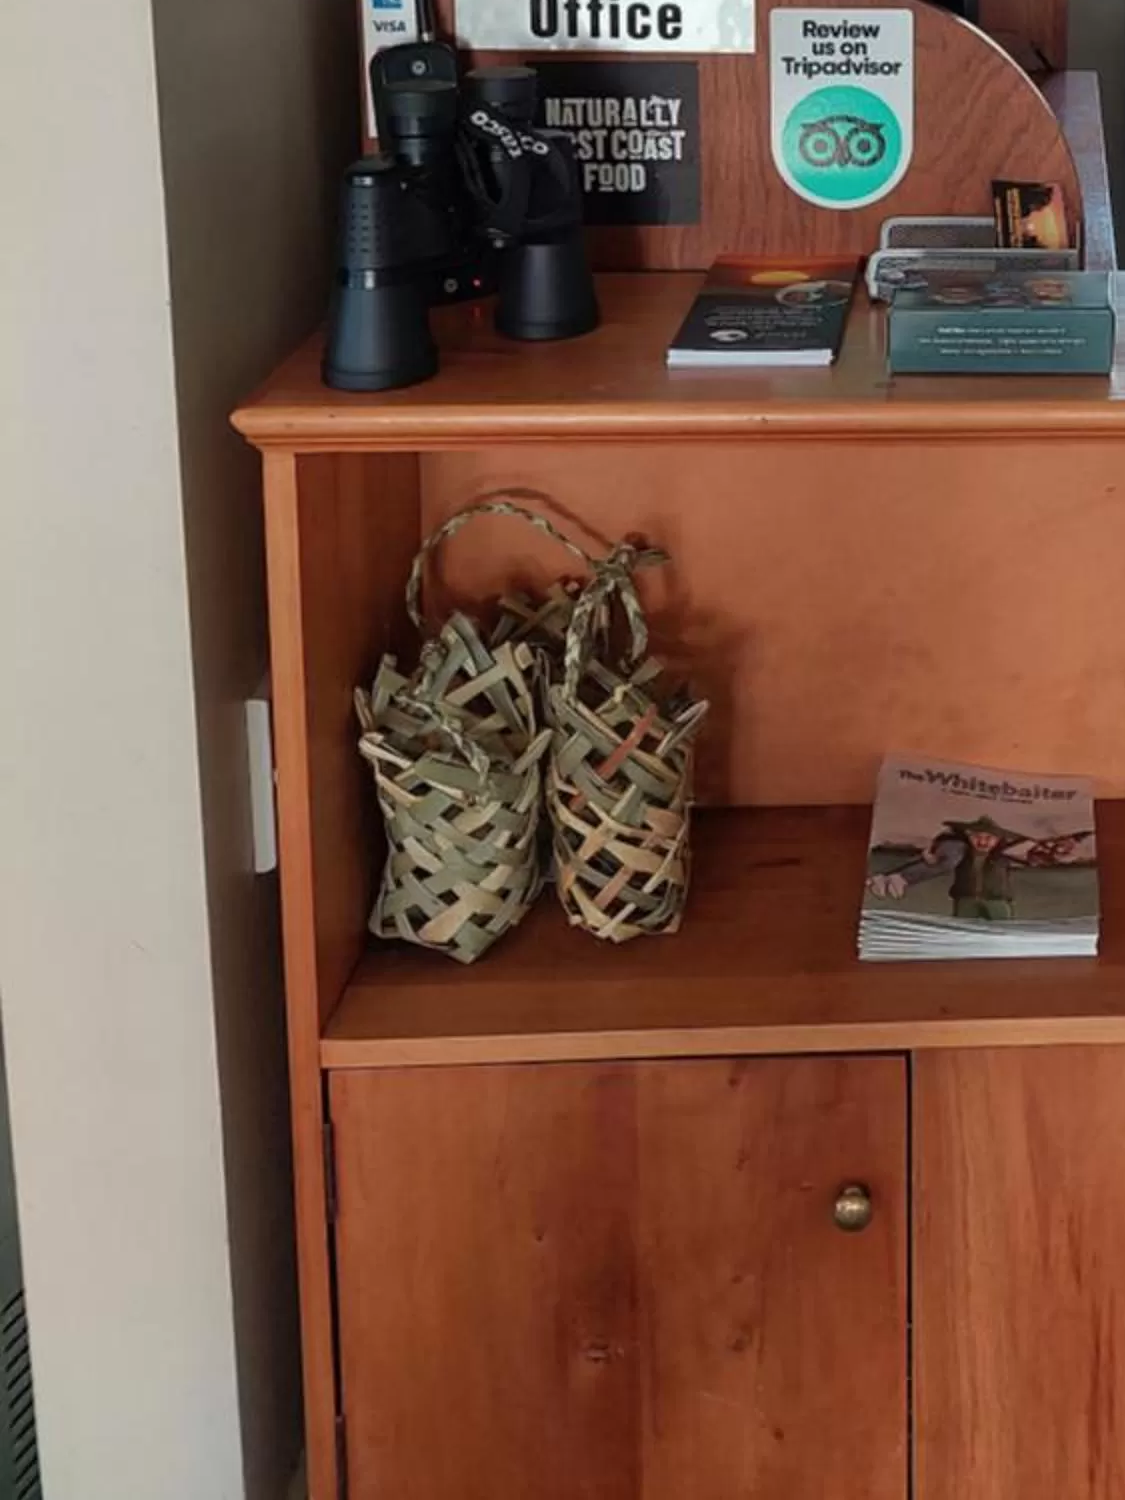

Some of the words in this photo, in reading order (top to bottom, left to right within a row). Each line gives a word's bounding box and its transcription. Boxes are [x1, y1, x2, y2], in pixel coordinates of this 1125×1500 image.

[372, 19, 407, 32] VISA
[802, 19, 880, 39] Review
[811, 41, 835, 56] us
[840, 41, 868, 56] on
[781, 56, 903, 79] Tripadvisor
[545, 96, 682, 127] NATURALLY
[611, 129, 687, 160] COAST
[583, 163, 647, 192] FOOD
[924, 769, 1078, 800] Whitebaiter
